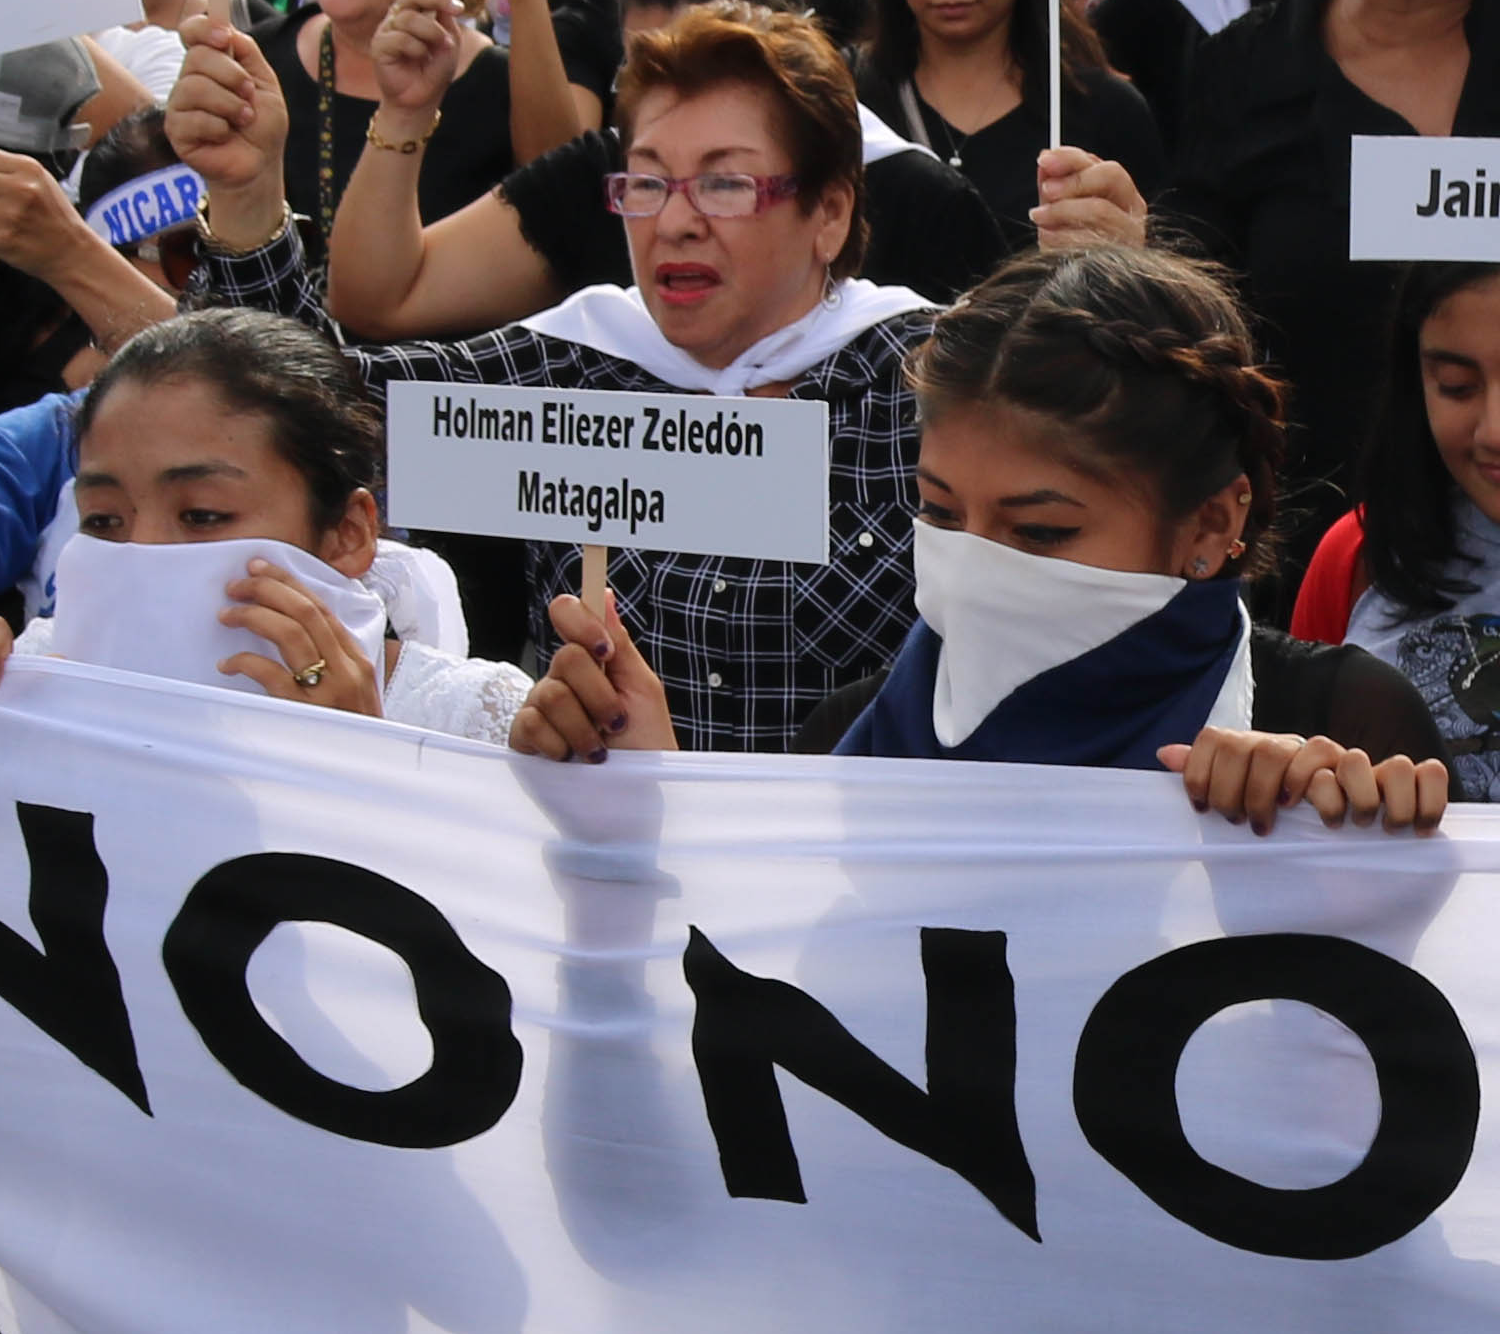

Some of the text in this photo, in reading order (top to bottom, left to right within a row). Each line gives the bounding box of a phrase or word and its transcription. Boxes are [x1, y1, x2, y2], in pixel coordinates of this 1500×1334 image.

[102, 173, 205, 247] NICAR
[432, 393, 765, 459] Holman Eliezer Zeledón
[515, 468, 668, 535] Matagalpa
